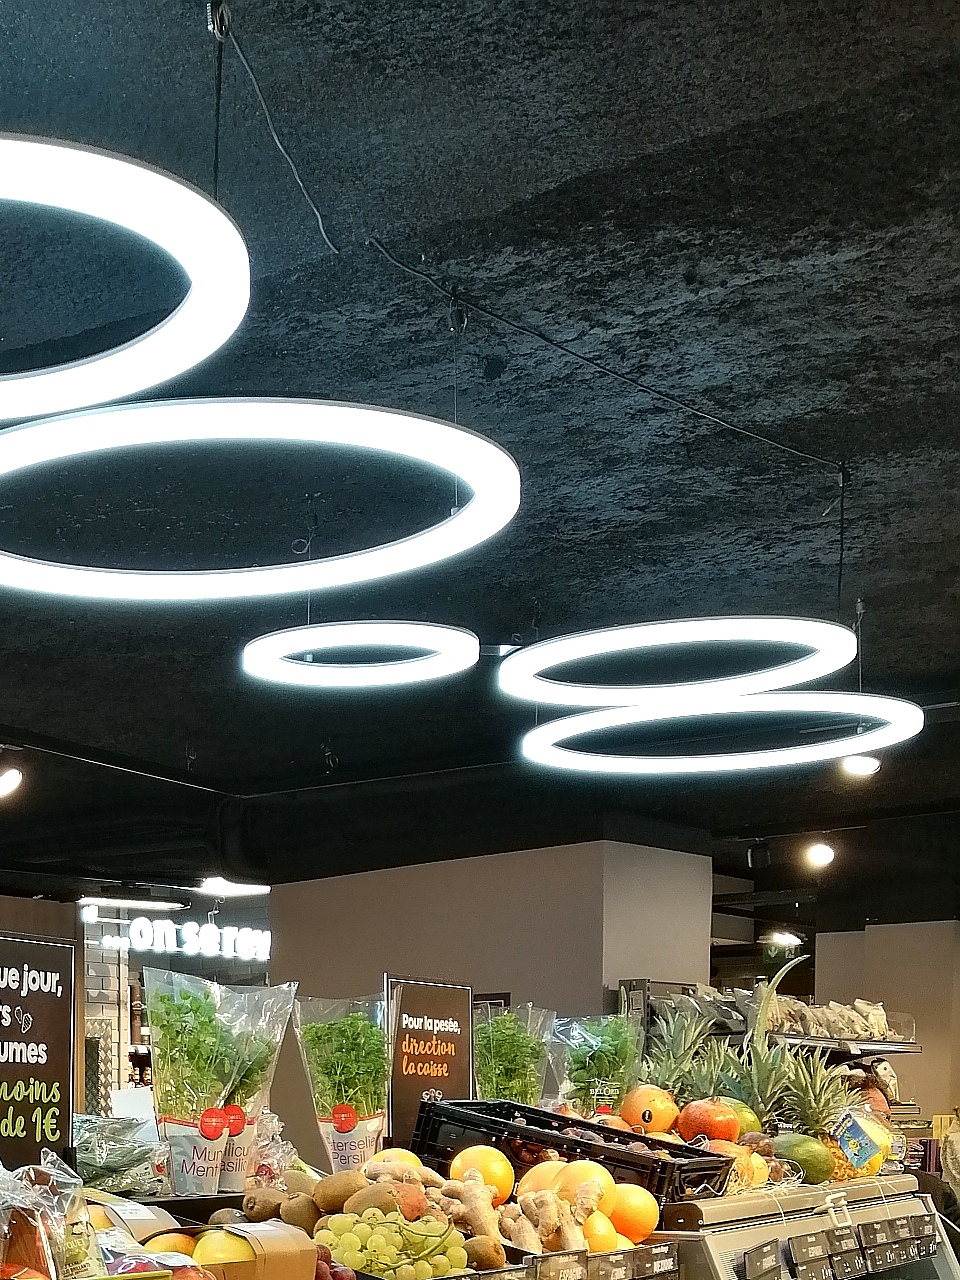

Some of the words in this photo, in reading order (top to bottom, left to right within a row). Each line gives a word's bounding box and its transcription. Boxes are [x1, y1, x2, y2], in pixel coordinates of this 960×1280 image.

[21, 963, 63, 998] jour,
[402, 1013, 424, 1030] Pour
[424, 1015, 434, 1031] la
[433, 1017, 461, 1035] pesée,
[402, 1033, 456, 1056] direction
[402, 1055, 416, 1075] la
[417, 1060, 449, 1077] caisse
[0, 1105, 27, 1138] de
